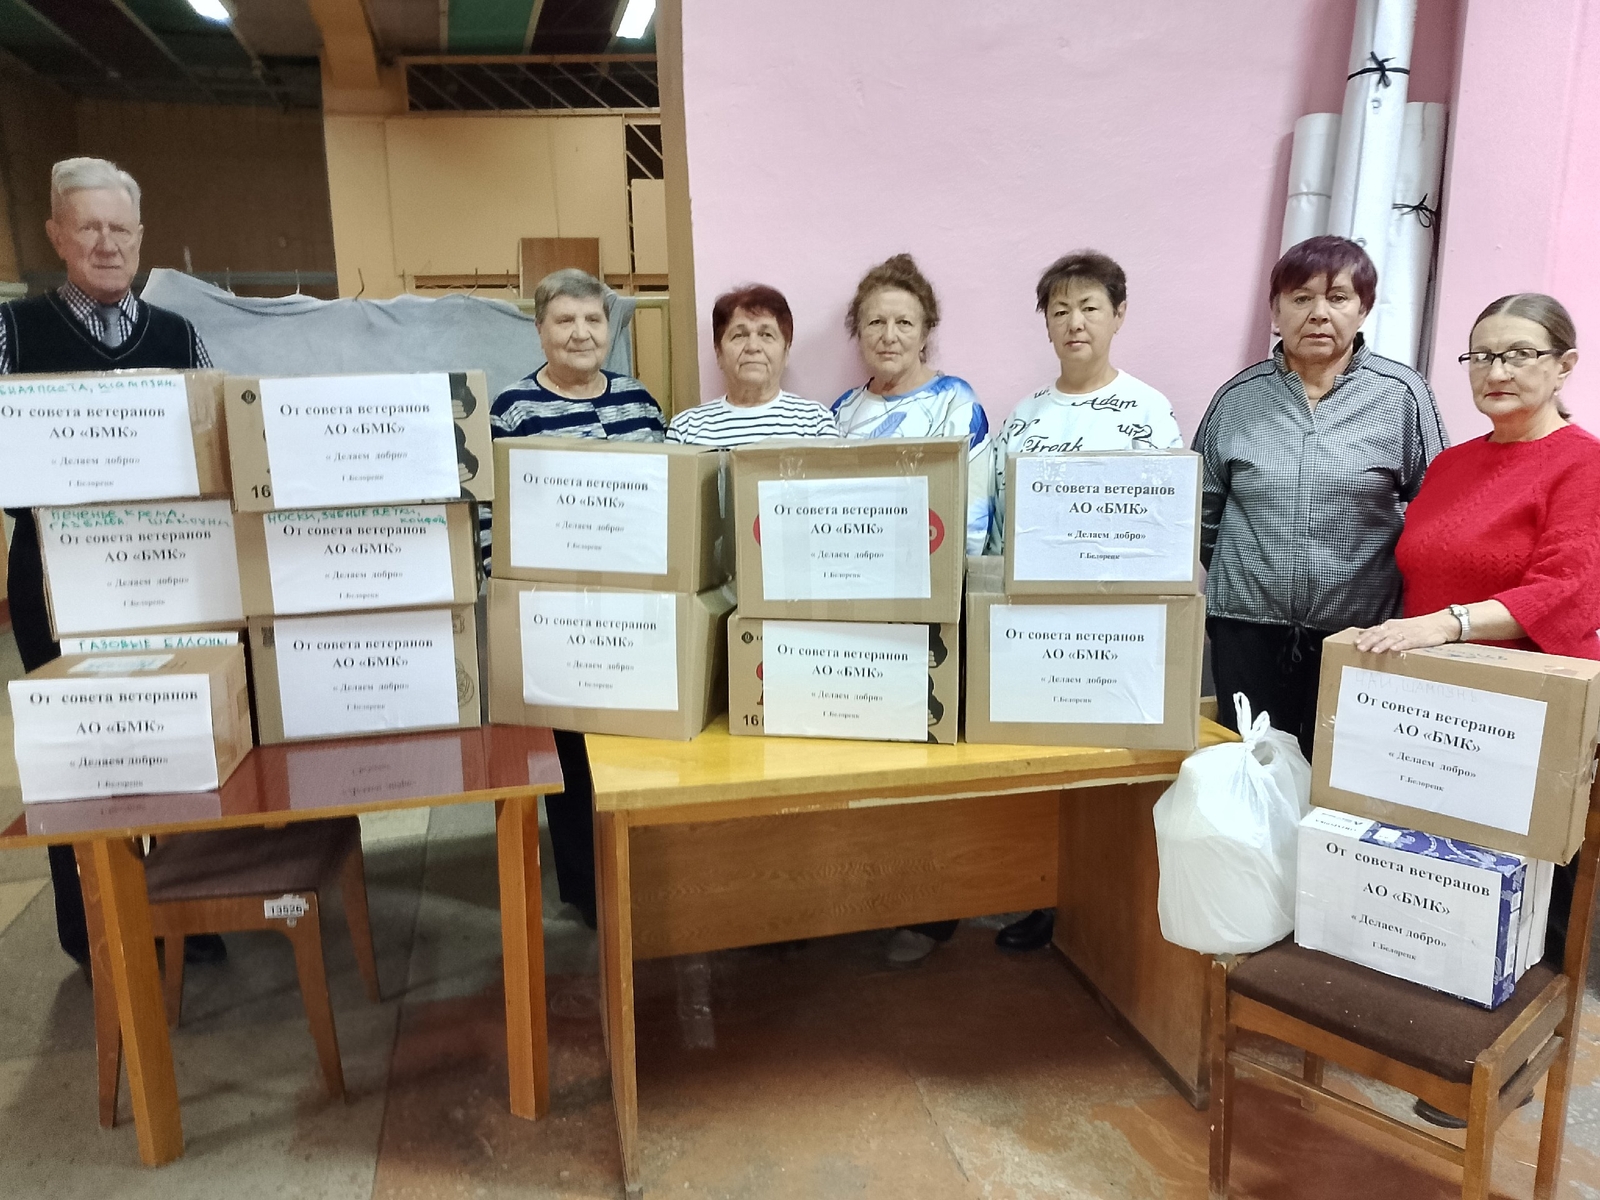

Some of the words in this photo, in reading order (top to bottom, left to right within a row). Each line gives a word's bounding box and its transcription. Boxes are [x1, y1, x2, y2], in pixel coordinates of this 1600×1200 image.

[1071, 393, 1138, 412] Adam
[1, 406, 22, 418] От
[29, 408, 81, 418] совета
[87, 408, 165, 420] ветеранов
[280, 405, 299, 416] От
[305, 406, 353, 415] совета
[358, 404, 430, 416] ветеранов
[49, 426, 75, 438] АО
[80, 426, 138, 438] «БМК»
[324, 423, 347, 435] АО
[352, 422, 405, 434] «БМК»
[523, 473, 539, 485] От
[543, 477, 582, 487] совета
[586, 479, 649, 491] ветеранов
[251, 484, 271, 499] 16
[1032, 482, 1051, 494] От
[1055, 484, 1100, 494] совета
[1104, 485, 1175, 498] ветеранов
[556, 494, 576, 505] АО
[579, 495, 625, 508] «БМК»
[1069, 501, 1093, 514] АО
[1095, 502, 1148, 515] «БМК»
[774, 504, 793, 515] От
[796, 506, 838, 515] совета
[842, 506, 908, 517] ветеранов
[283, 525, 300, 536] От
[308, 527, 353, 536] совета
[358, 526, 427, 537] ветеранов
[810, 522, 832, 534] АО
[835, 522, 884, 534] «БМК»
[60, 534, 79, 545] От
[85, 534, 133, 544] совета
[138, 530, 211, 543] ветеранов
[324, 543, 346, 555] АО
[350, 540, 402, 555] «БМК»
[105, 550, 128, 563] АО
[133, 548, 186, 561] «БМК»
[533, 614, 548, 625] От
[553, 618, 592, 628] совета
[595, 620, 657, 631] ветеранов
[567, 633, 586, 645] АО
[589, 634, 634, 647] «БМК»
[1005, 628, 1025, 640] От
[1028, 632, 1071, 641] совета
[1076, 633, 1145, 642] ветеранов
[293, 640, 311, 651] От
[317, 640, 360, 650] совета
[366, 639, 433, 652] ветеранов
[777, 645, 795, 655] От
[798, 648, 839, 658] совета
[843, 650, 908, 661] ветеранов
[1042, 648, 1064, 659] АО
[1068, 648, 1118, 661] «БМК»
[333, 657, 354, 669] АО
[359, 656, 408, 668] «БМК»
[812, 664, 833, 676] АО
[836, 666, 884, 678] «БМК»
[29, 693, 50, 705] От
[61, 693, 113, 704] совета
[118, 691, 198, 703] ветеранов
[742, 714, 759, 727] 16
[1357, 692, 1378, 706] От
[1381, 701, 1430, 721] совета
[1433, 713, 1516, 739] ветеранов
[76, 722, 101, 735] АО
[106, 720, 164, 734] «БМК»
[1393, 722, 1419, 738] АО
[1424, 731, 1481, 753] «БМК»
[1326, 843, 1348, 857] От
[1355, 851, 1404, 873] совета
[1409, 868, 1490, 897] ветеранов
[1363, 882, 1388, 897] АО
[1392, 891, 1450, 915] «БМК»
